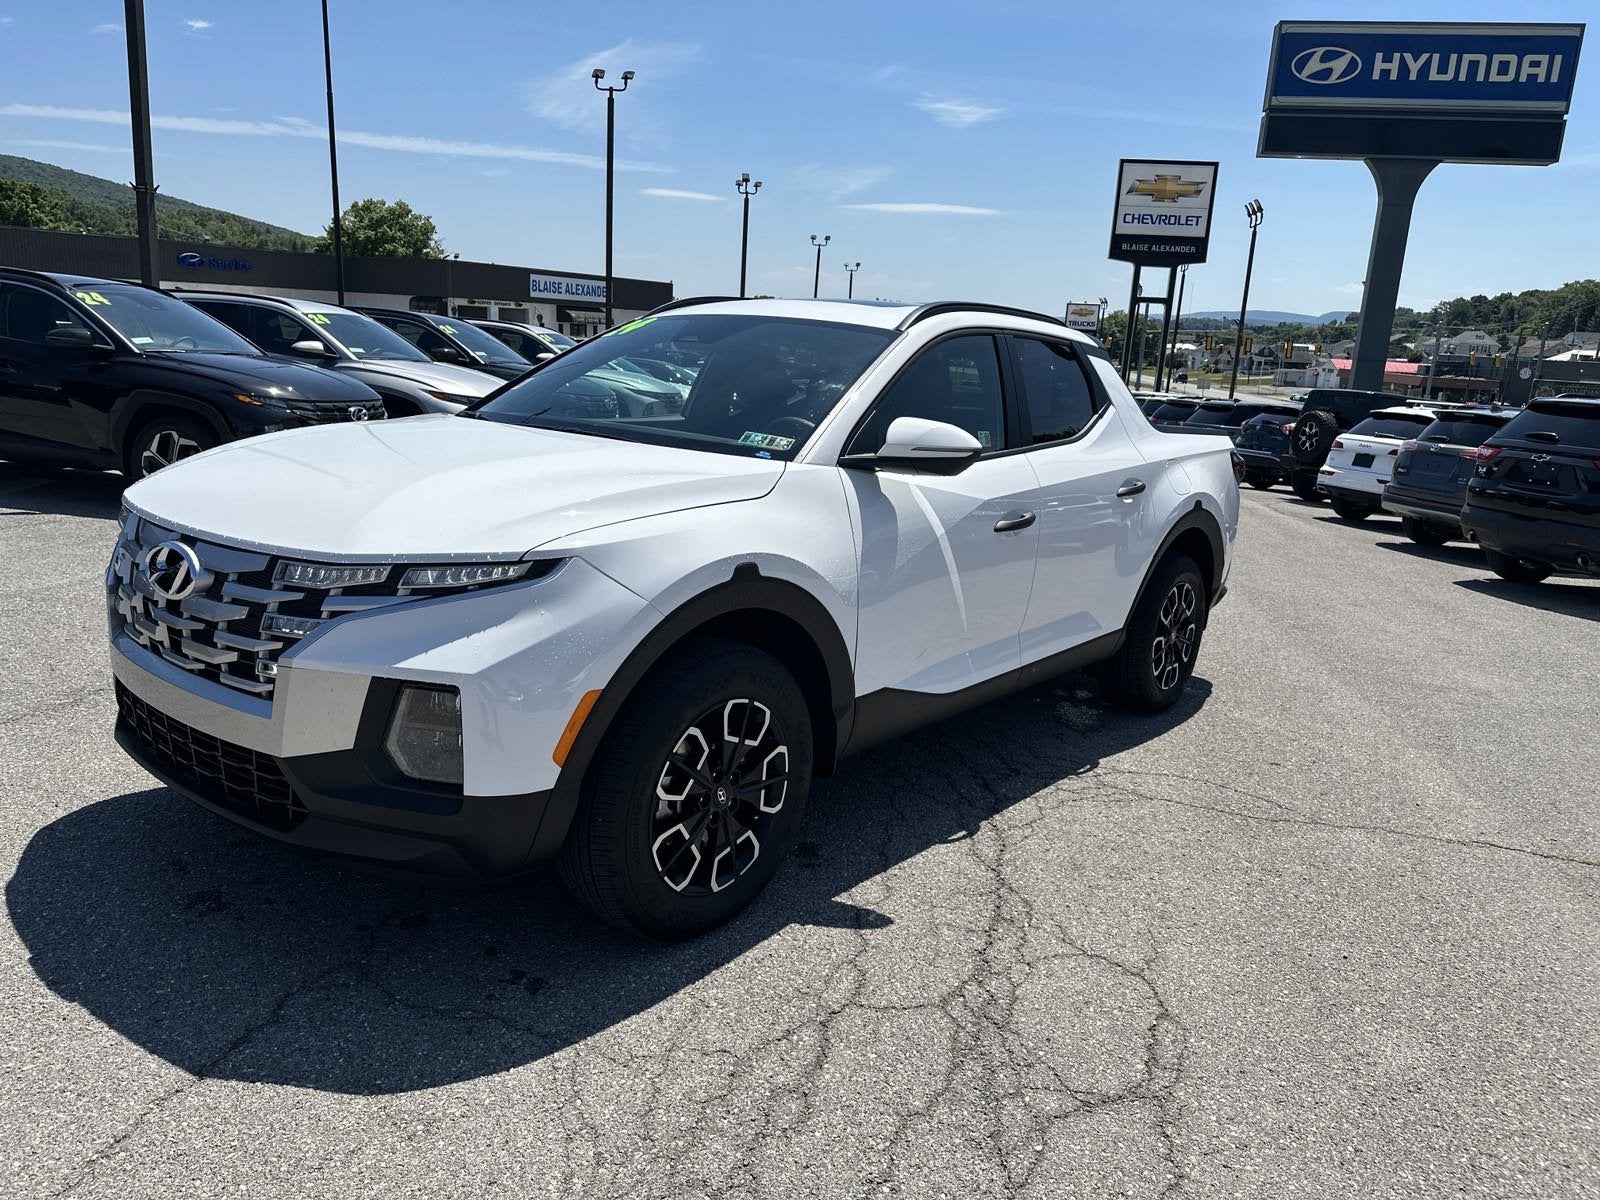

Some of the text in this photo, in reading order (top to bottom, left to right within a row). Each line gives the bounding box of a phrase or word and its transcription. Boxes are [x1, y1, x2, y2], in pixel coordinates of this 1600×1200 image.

[1372, 52, 1562, 82] HYUNDAI
[1123, 213, 1202, 226] CHEVROLET
[1121, 243, 1196, 253] BLAISE ALEXANDER
[532, 280, 606, 297] BLAISE ALEXANDE
[76, 291, 112, 305] 24
